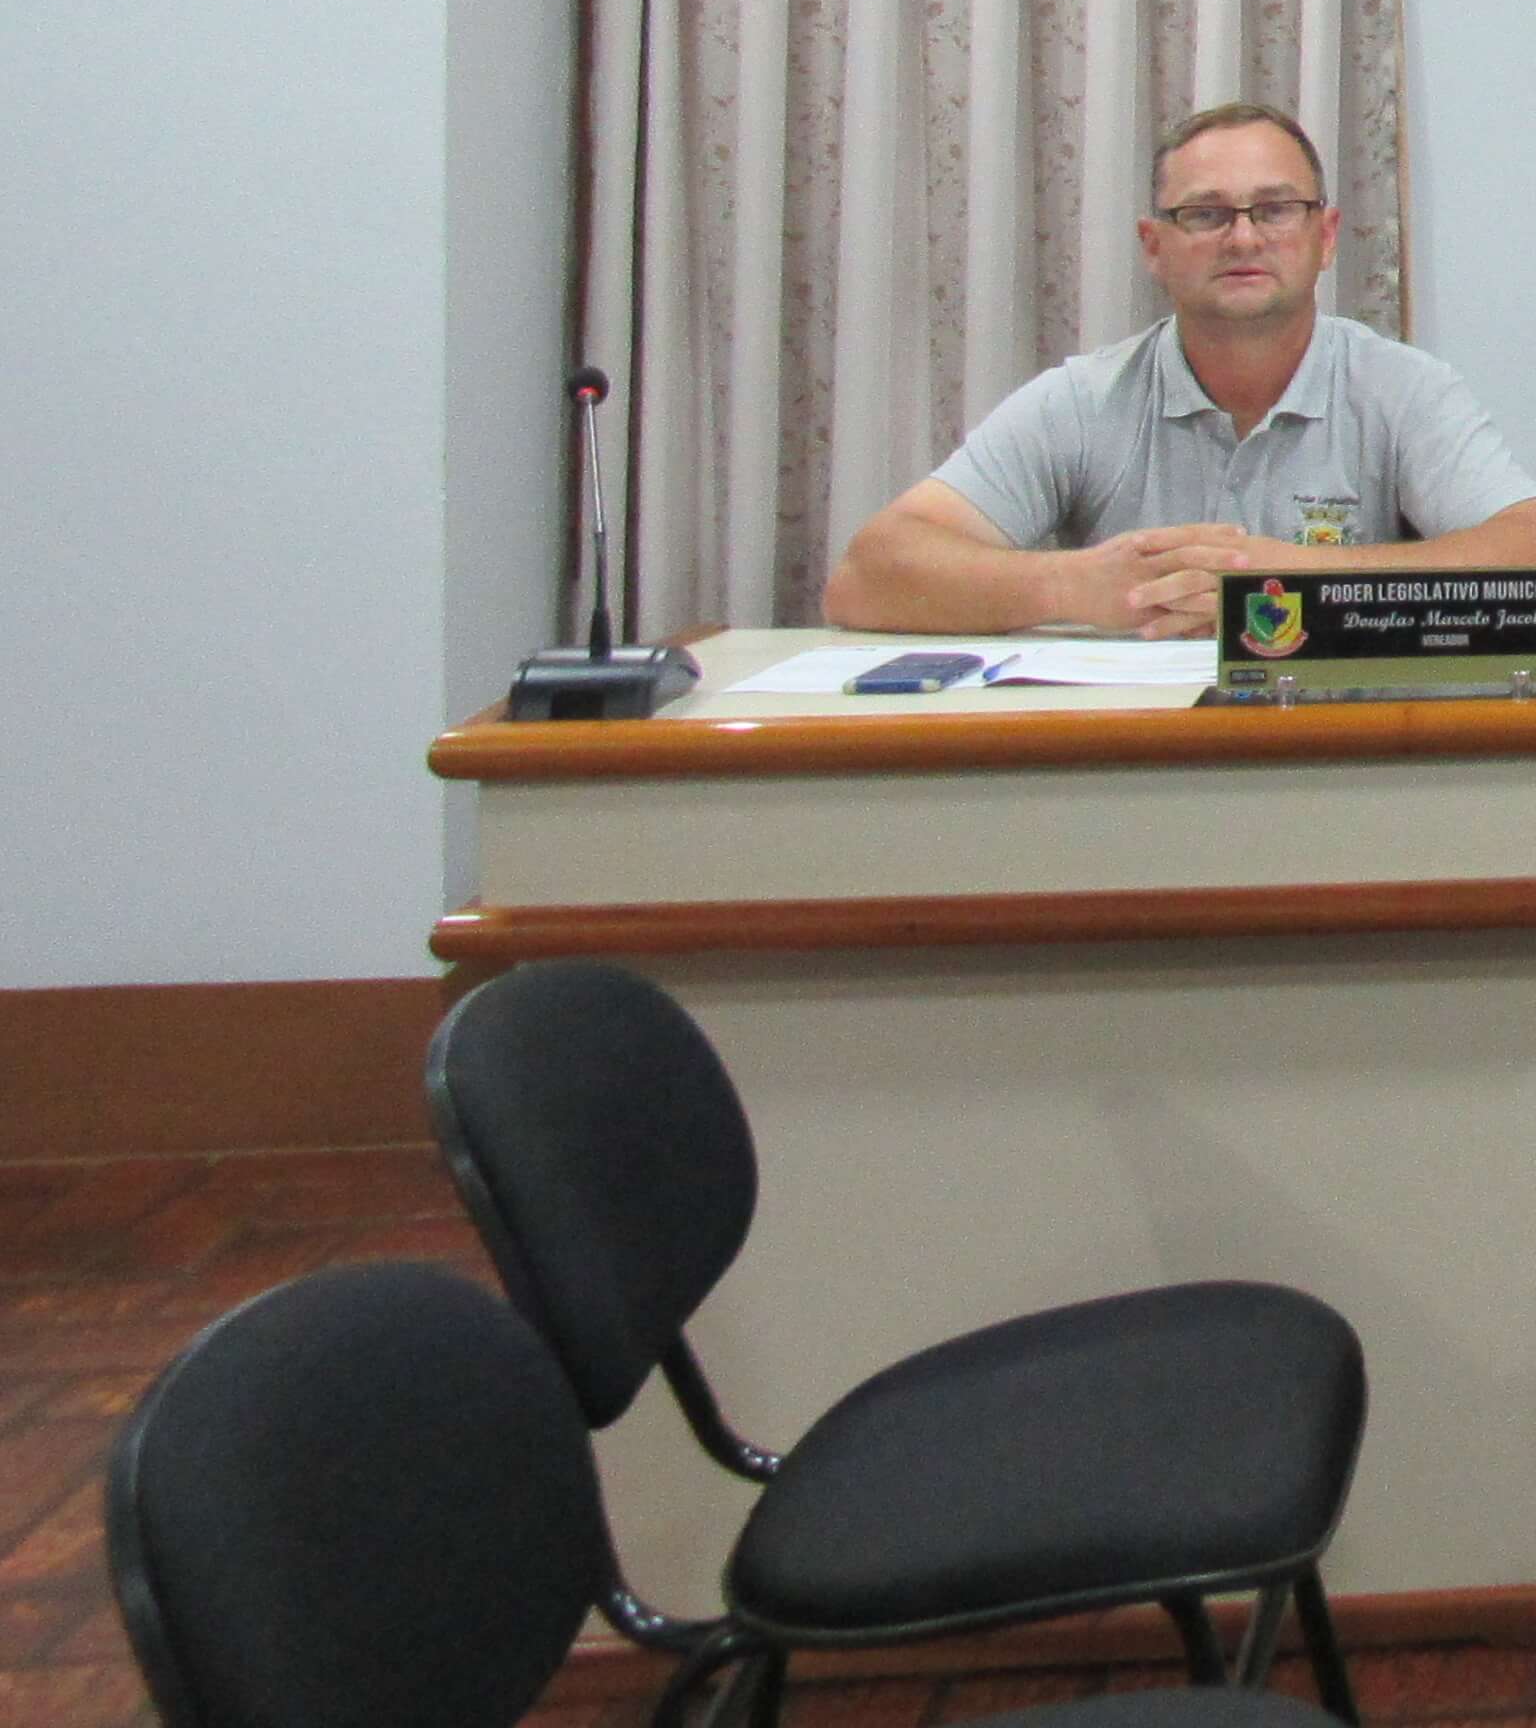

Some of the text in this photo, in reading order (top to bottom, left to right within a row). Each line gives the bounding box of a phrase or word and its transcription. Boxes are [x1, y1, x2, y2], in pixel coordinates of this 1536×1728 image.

[1320, 583, 1374, 603] PODER
[1378, 581, 1479, 602] LEGISLATIVO
[1343, 611, 1415, 632] Douglas
[1420, 609, 1491, 627] Marcelo
